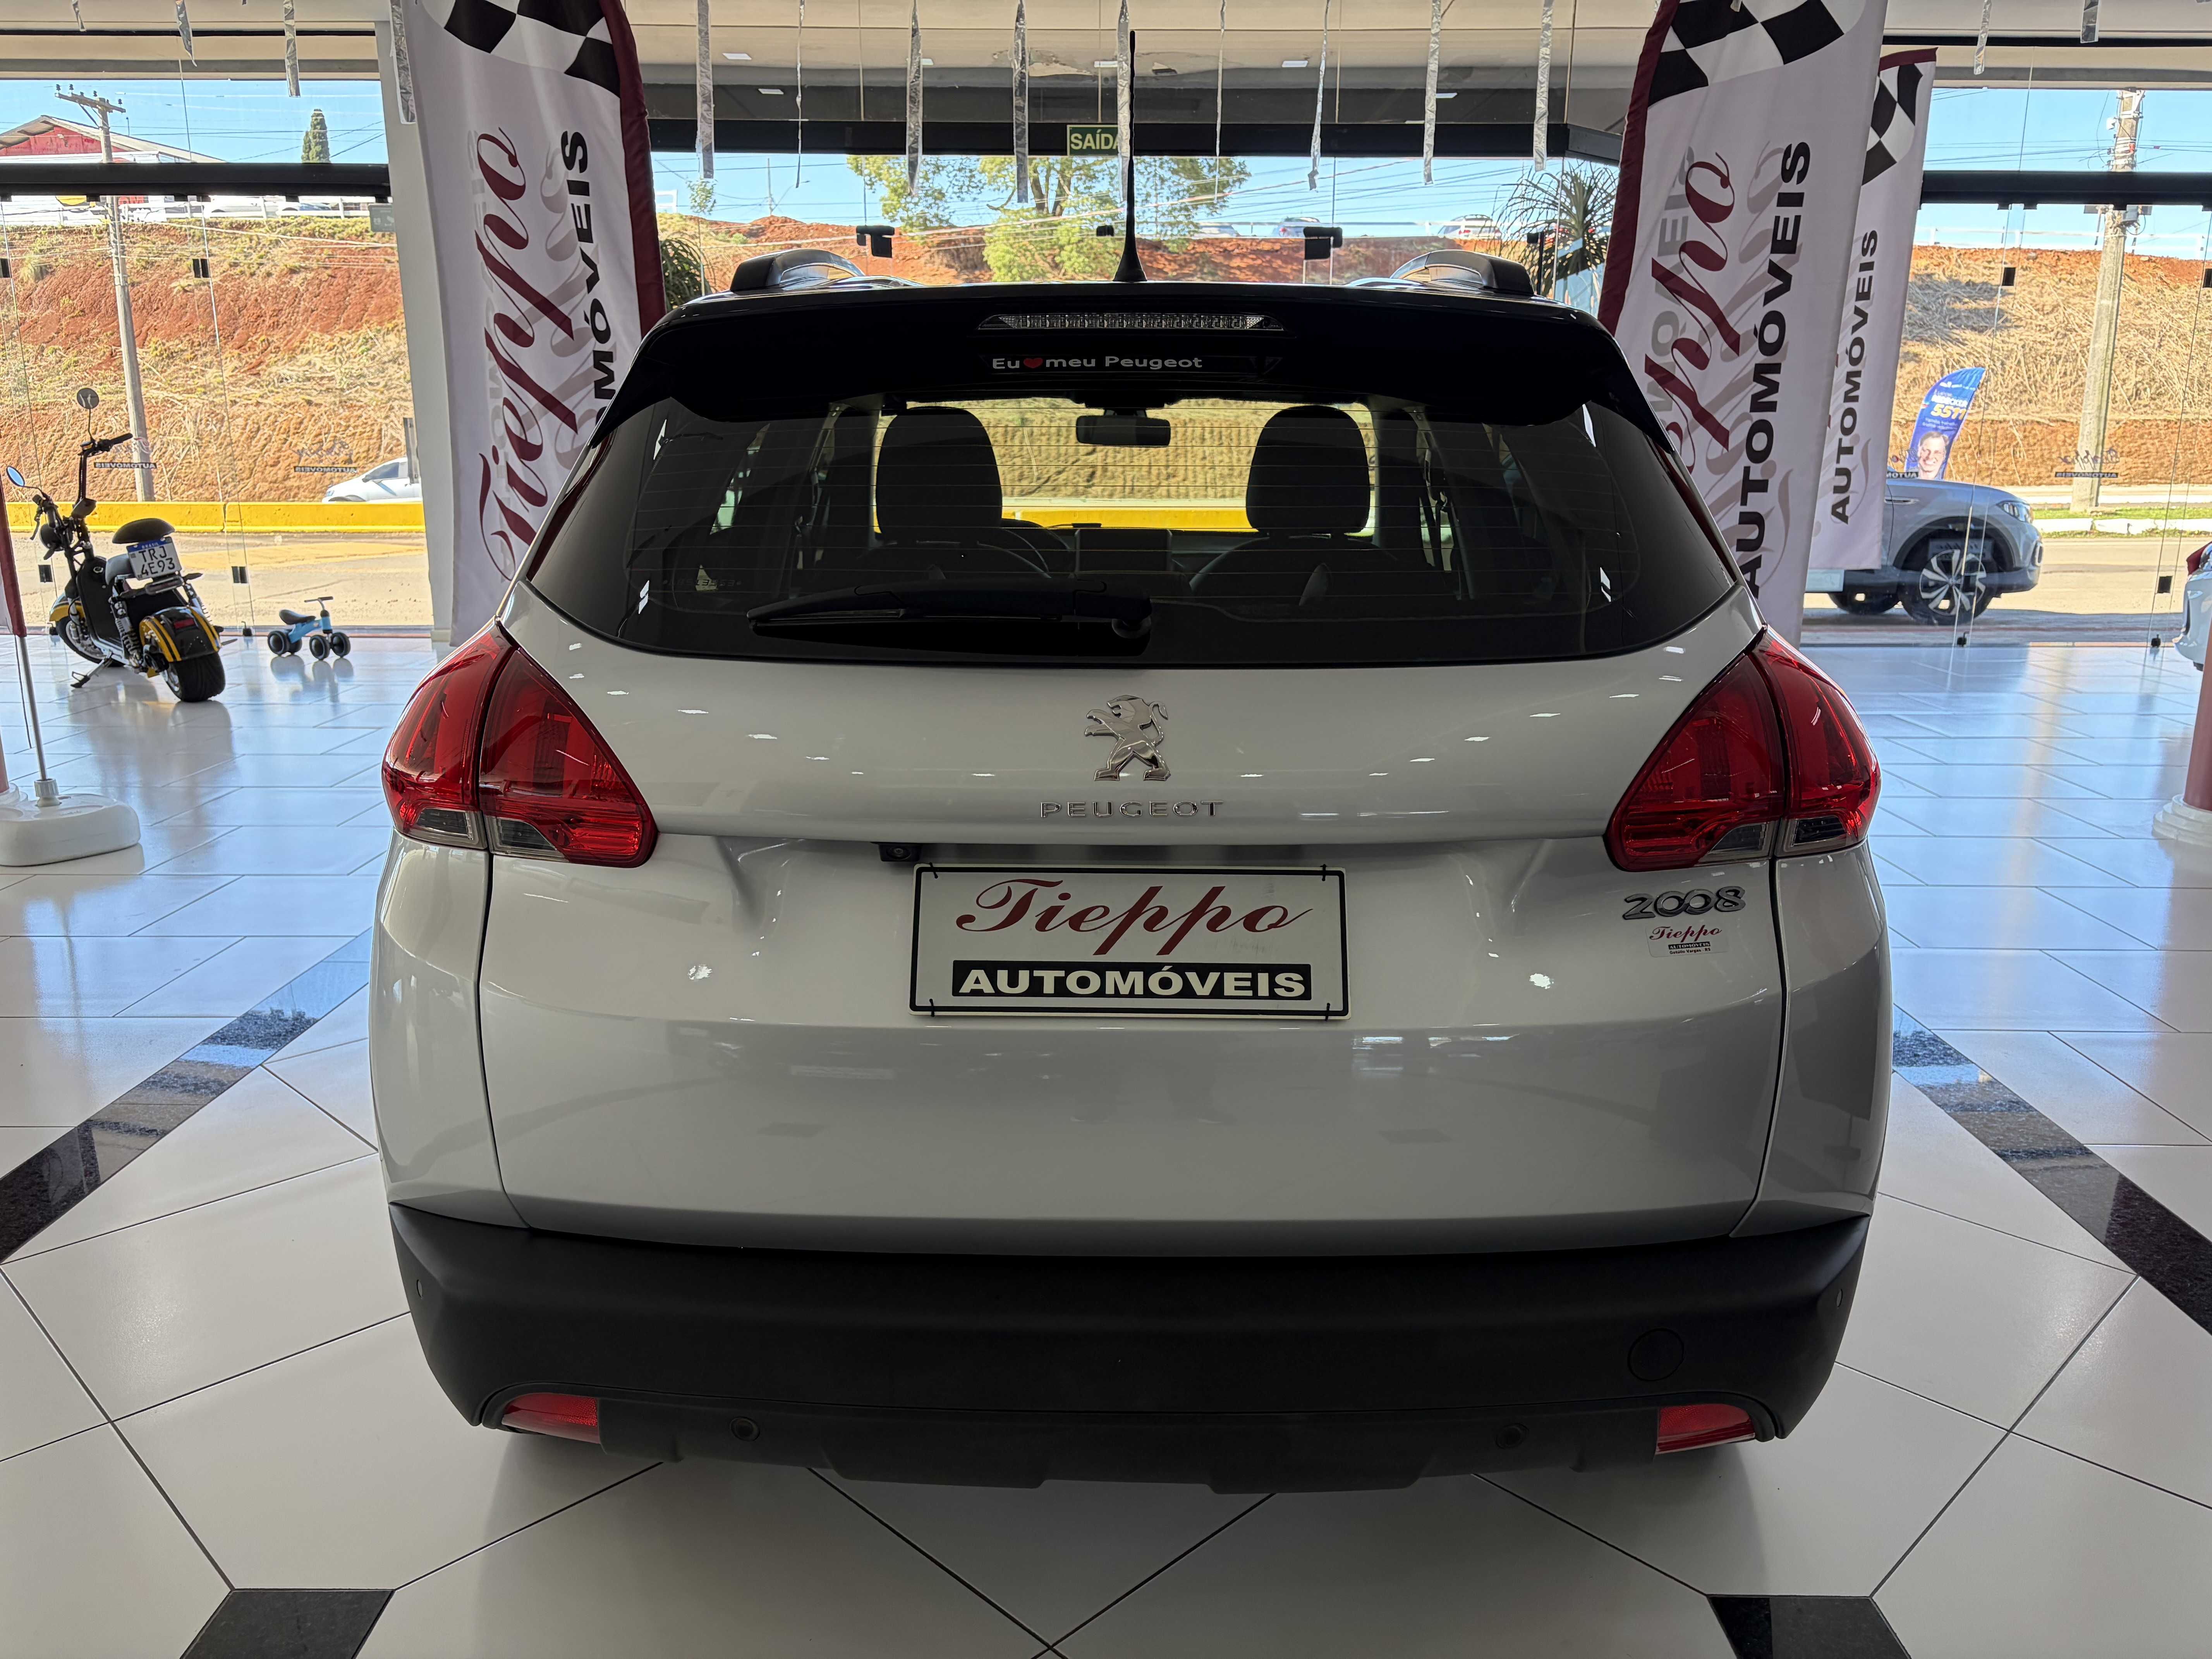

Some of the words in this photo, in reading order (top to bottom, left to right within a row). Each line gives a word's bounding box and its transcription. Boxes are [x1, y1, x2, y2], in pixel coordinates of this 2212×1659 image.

[561, 131, 616, 426] MÓVEIS
[475, 127, 578, 581] Tieppo
[992, 358, 1020, 369] Eu
[1046, 357, 1096, 368] meu
[1105, 356, 1203, 369] Peugeot
[1735, 142, 1810, 599] AUTOMÓVEIS
[1831, 230, 1878, 524] AUTOMÓVEIS
[1930, 404, 1967, 419] 5511
[139, 546, 167, 562] TRJ
[141, 557, 175, 576] 4E93
[1040, 800, 1224, 817] PEUGEOT
[956, 878, 1314, 956] Tieppo
[1622, 886, 1746, 920] 2008
[1649, 925, 1723, 943] Tieppo
[958, 965, 1305, 998] AUTOMÓVEIS
